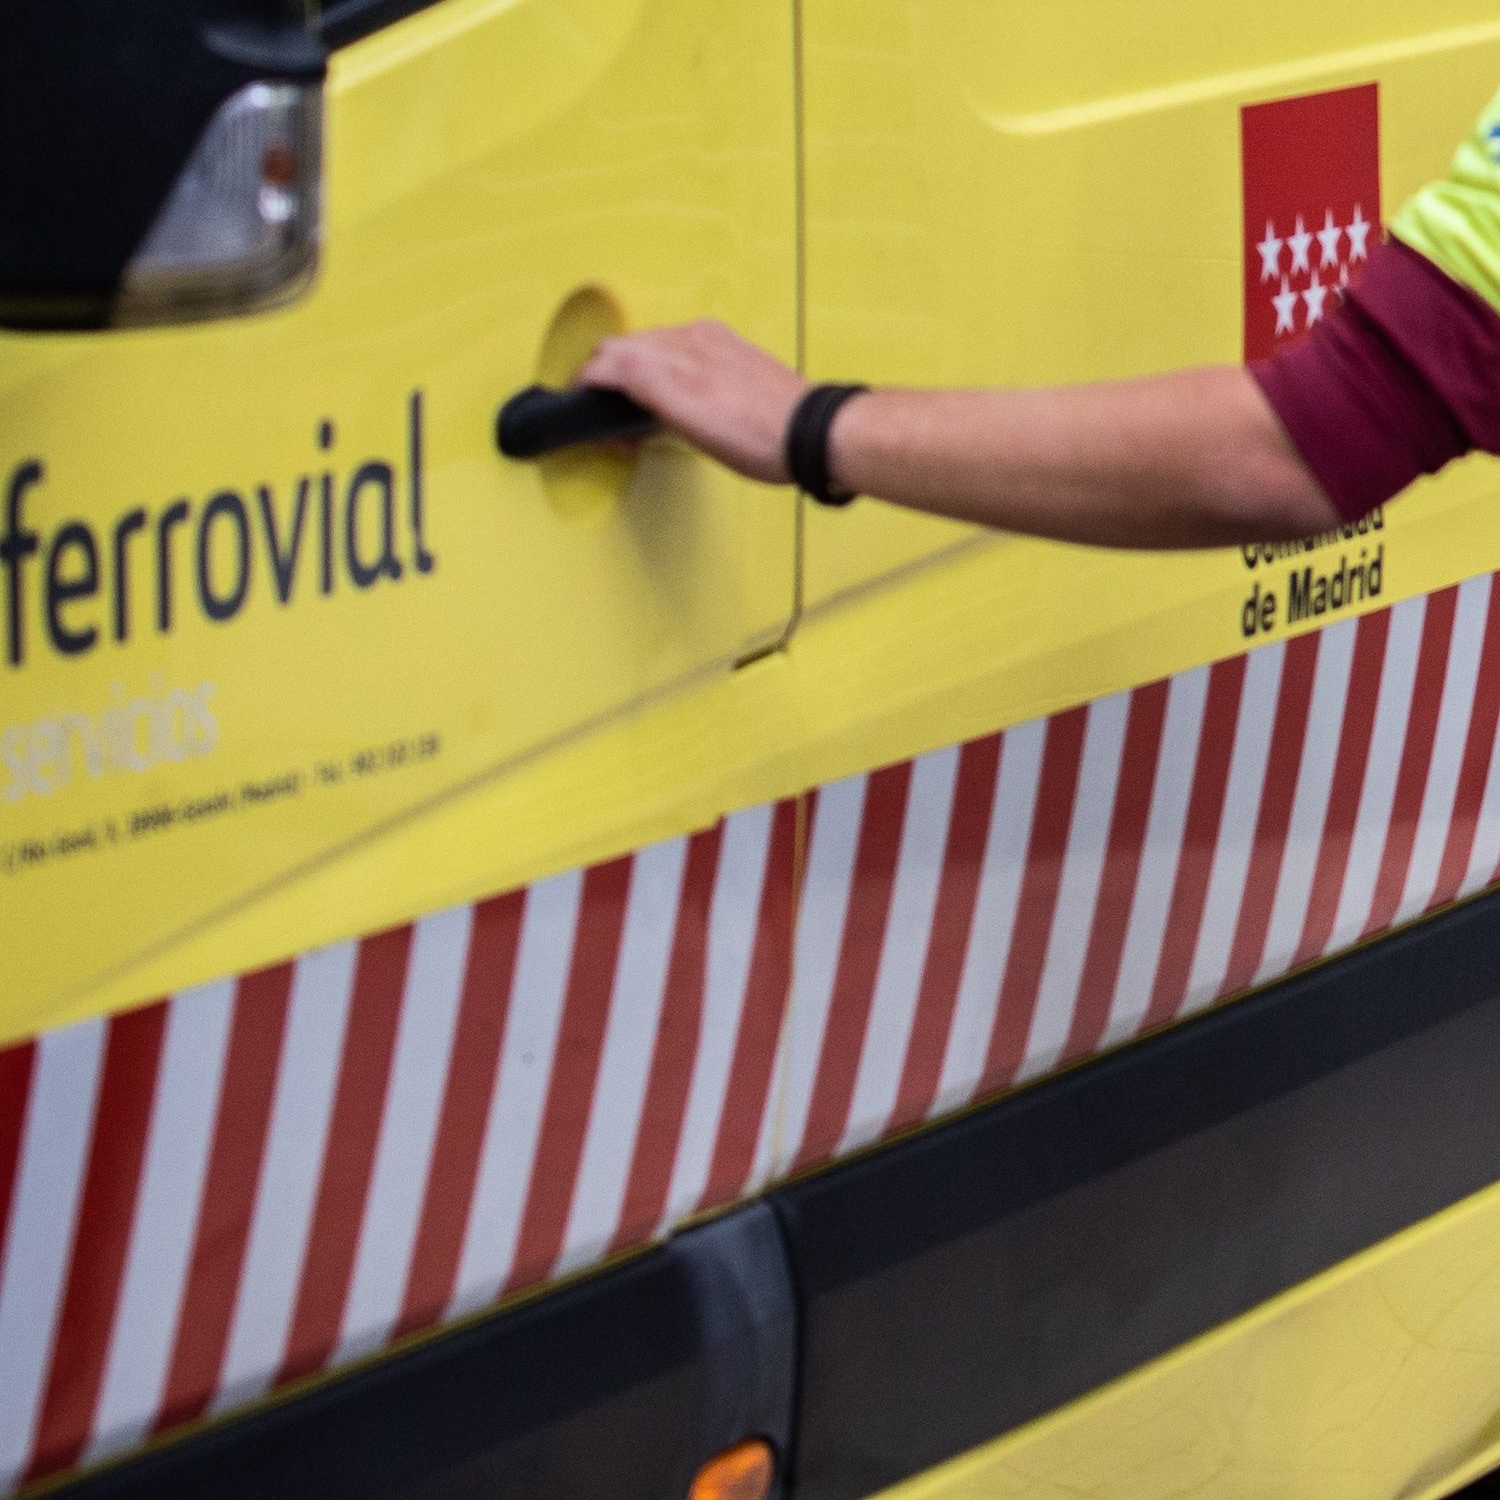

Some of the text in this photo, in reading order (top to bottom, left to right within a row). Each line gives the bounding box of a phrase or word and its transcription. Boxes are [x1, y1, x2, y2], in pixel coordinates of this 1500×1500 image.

[0, 390, 436, 668] ferrovial
[1243, 542, 1383, 637] de Madrid
